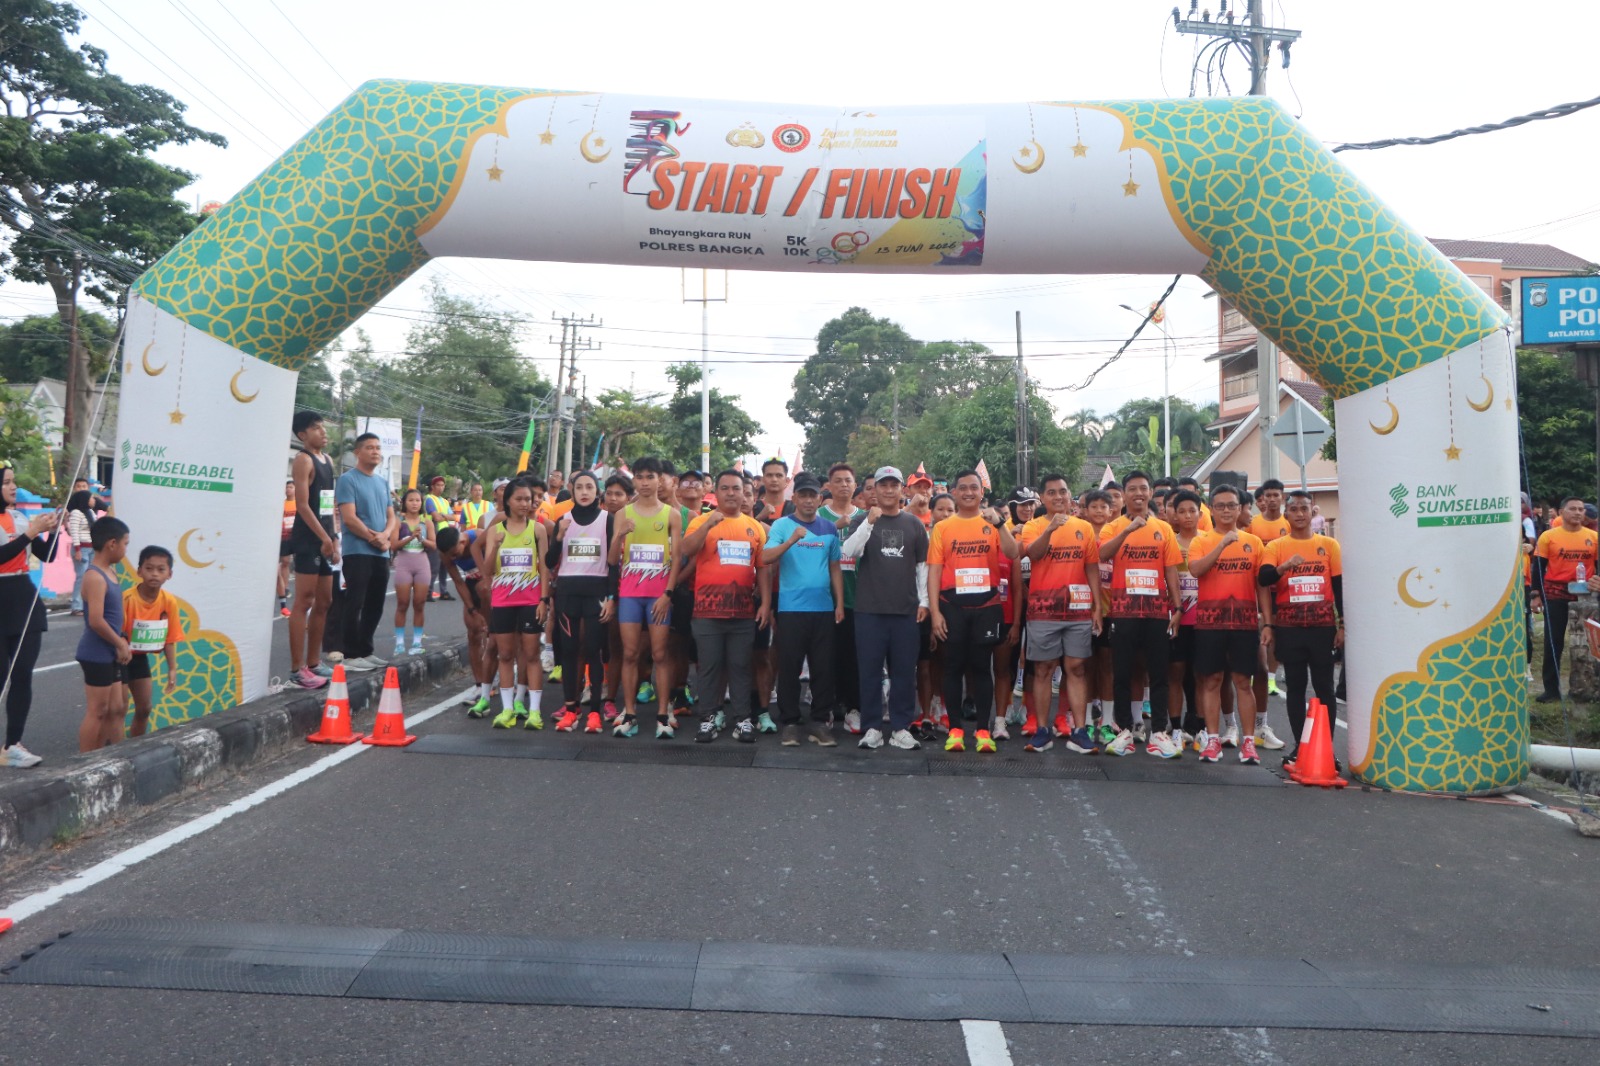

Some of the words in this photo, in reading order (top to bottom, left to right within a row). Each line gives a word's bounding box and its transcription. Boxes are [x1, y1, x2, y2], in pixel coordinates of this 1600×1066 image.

[648, 161, 784, 215] START
[783, 168, 820, 217] /
[820, 168, 962, 220] FINISH
[649, 227, 726, 239] Bhayangkara
[728, 231, 751, 240] RUN
[786, 235, 807, 247] 5K
[639, 241, 695, 252] POLRES
[699, 244, 765, 256] BANGKA
[783, 247, 810, 257] 10K
[895, 243, 924, 253] JUNI
[929, 241, 957, 250] 2026
[1559, 308, 1600, 326] PO
[1548, 329, 1596, 338] SATLANTAS
[134, 443, 168, 458] BANK
[133, 458, 235, 480] SUMSELBABEL
[150, 476, 211, 490] SYARIAH
[1416, 484, 1457, 498] BANK
[1442, 514, 1501, 526] SYARIAH
[572, 545, 577, 554] F
[578, 545, 596, 554] 2013
[721, 547, 729, 556] M
[956, 545, 977, 555] RUN
[978, 544, 990, 553] 80
[509, 555, 529, 564] 3002
[633, 552, 640, 560] M
[641, 551, 660, 560] 3001
[1051, 551, 1071, 560] RUN
[1072, 550, 1084, 559] 80
[1127, 551, 1148, 559] RUN
[1217, 562, 1238, 571] RUN
[1240, 561, 1252, 570] 80
[1292, 565, 1312, 574] RUN
[1313, 564, 1325, 573] 80
[1129, 576, 1137, 585] M
[1294, 584, 1299, 593] F
[1301, 583, 1320, 592] 1032
[137, 630, 146, 640] M
